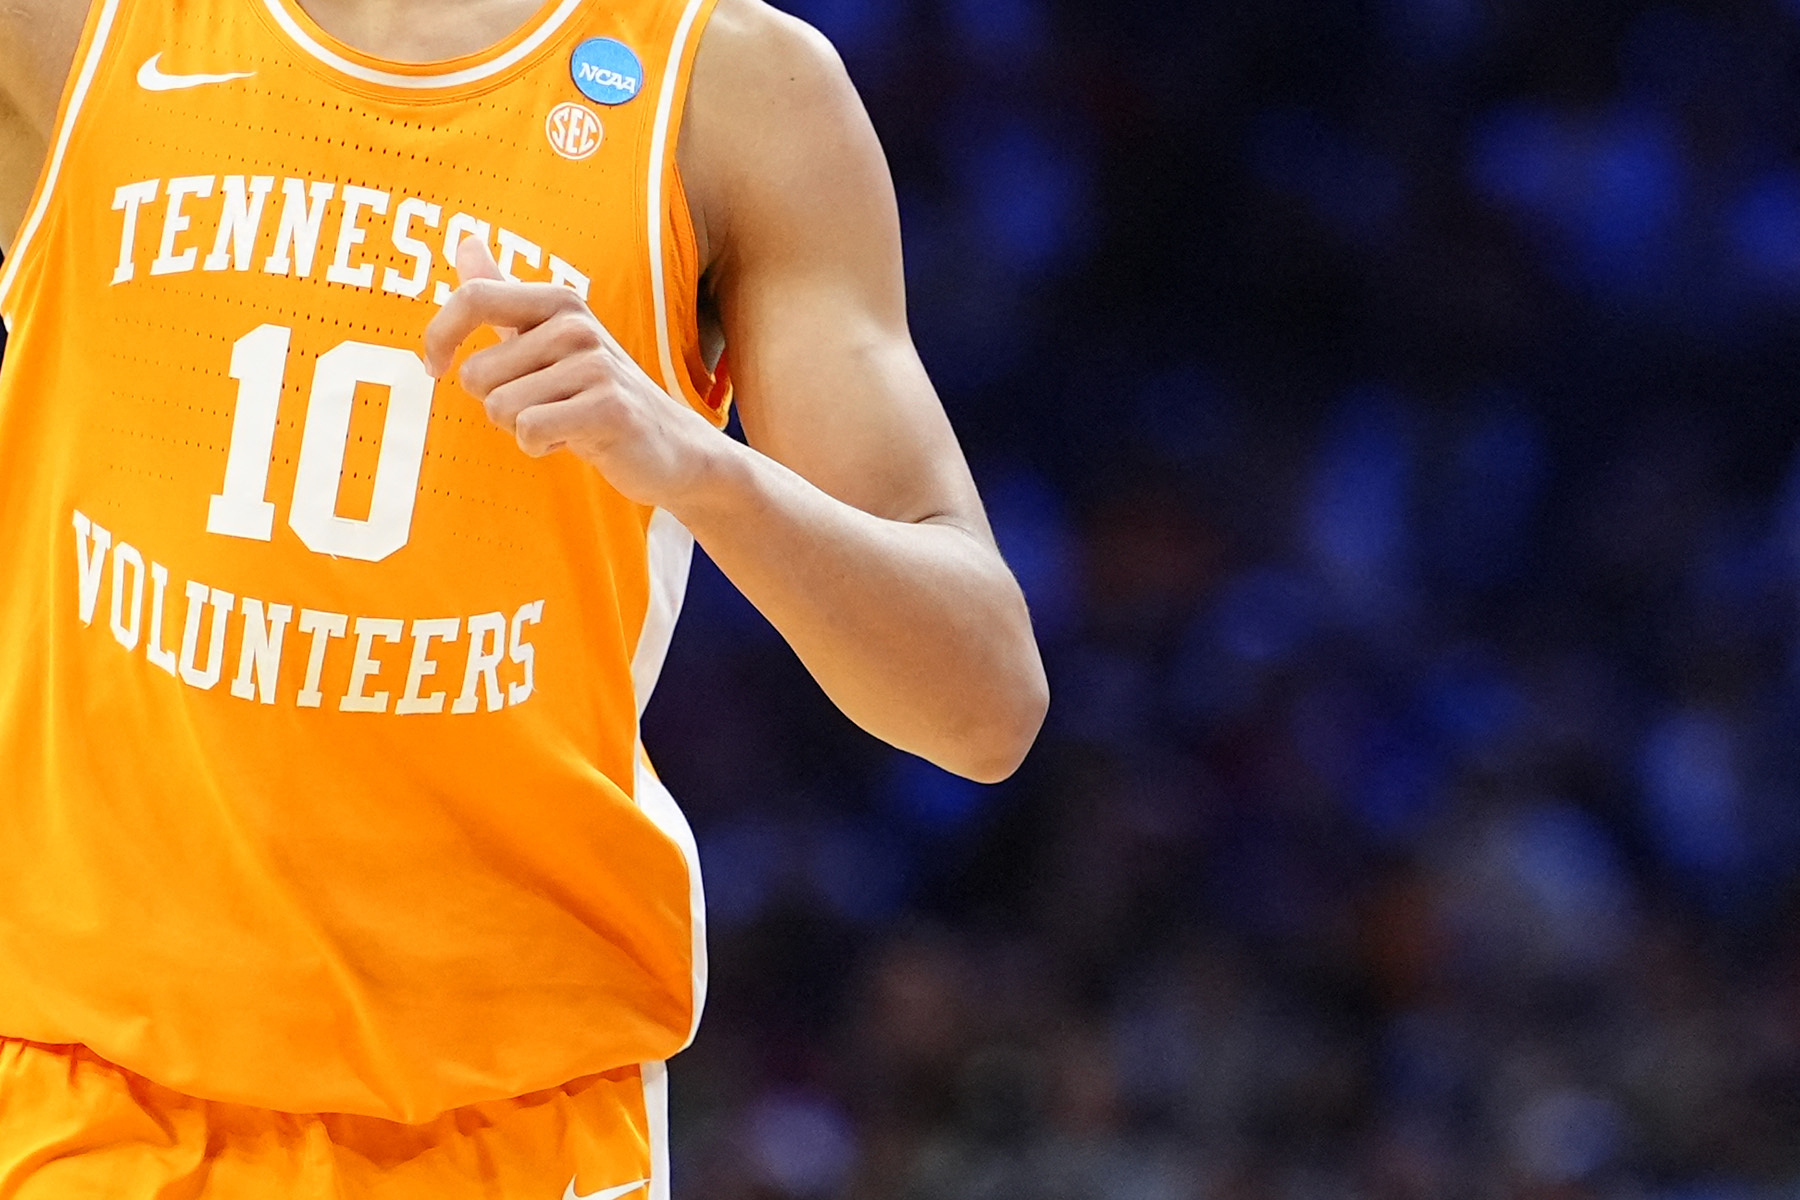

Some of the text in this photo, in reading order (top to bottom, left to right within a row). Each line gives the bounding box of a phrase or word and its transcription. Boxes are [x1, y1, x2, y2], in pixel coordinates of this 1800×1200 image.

[551, 106, 598, 154] SEC
[578, 62, 636, 94] NCAA
[206, 323, 436, 562] 10
[72, 509, 545, 714] VOLUNTEERS
